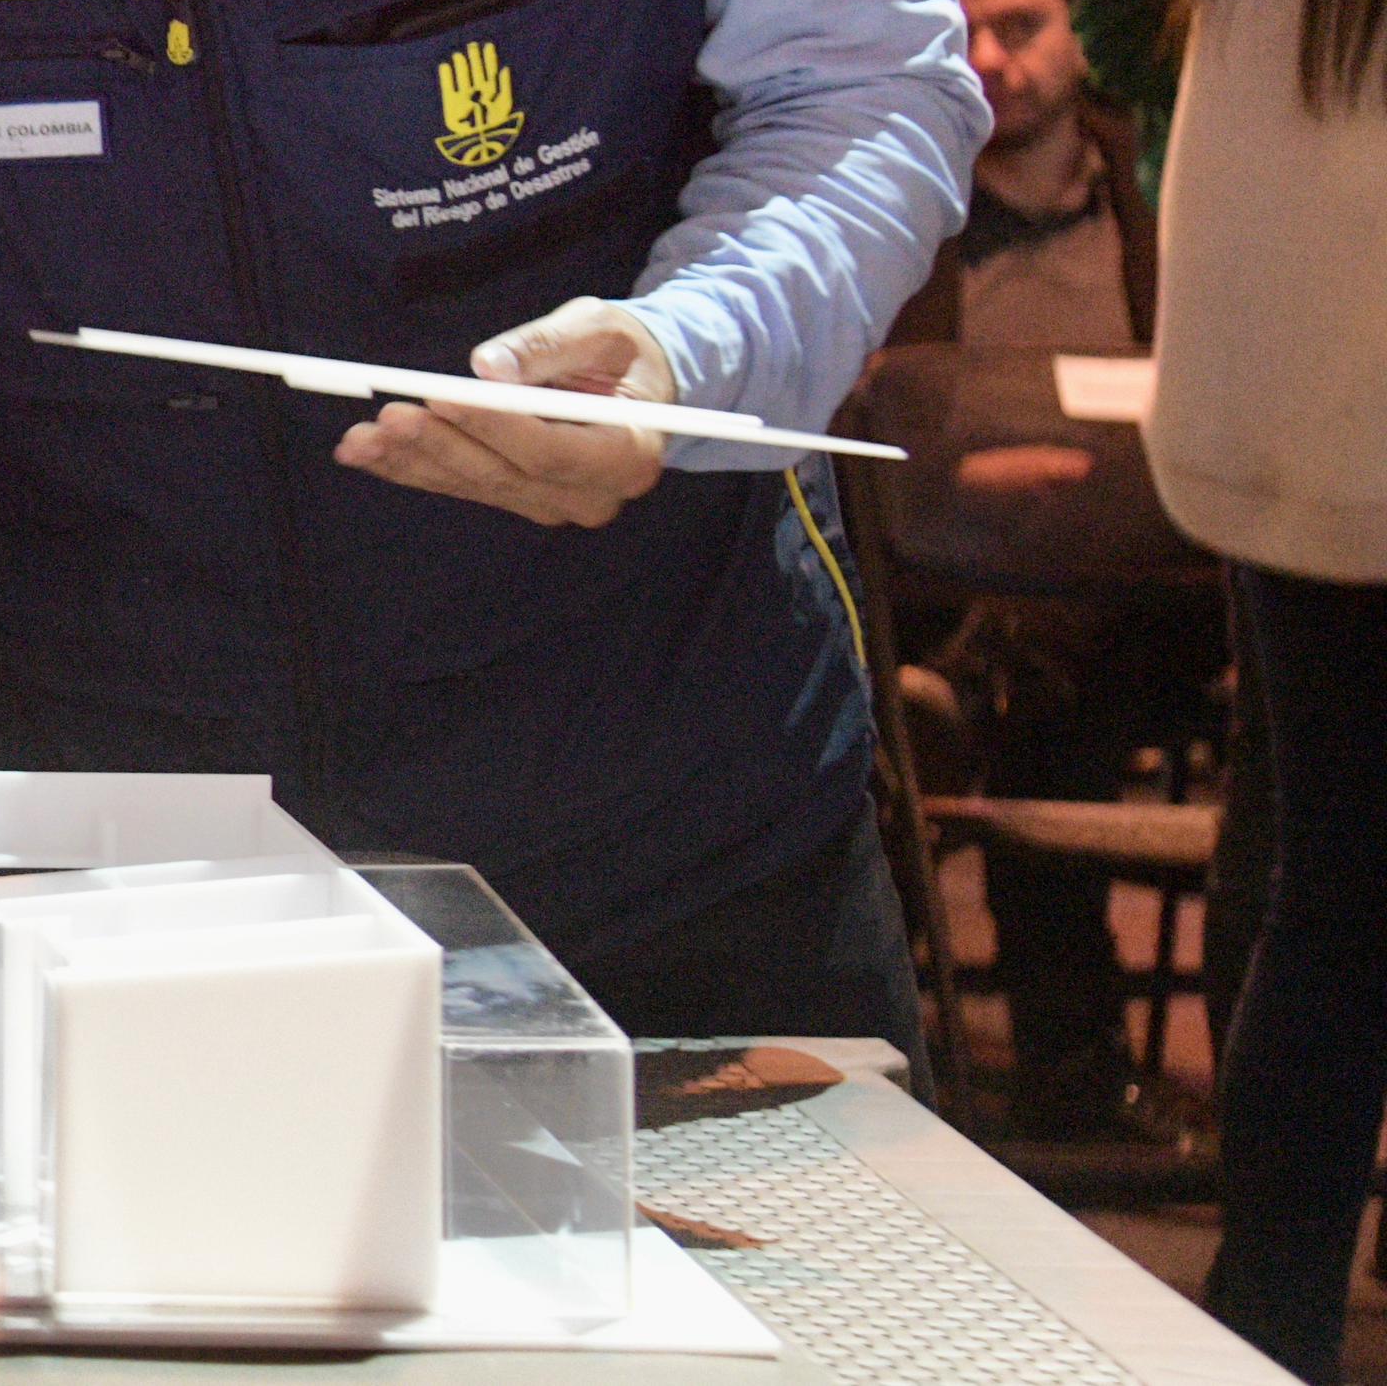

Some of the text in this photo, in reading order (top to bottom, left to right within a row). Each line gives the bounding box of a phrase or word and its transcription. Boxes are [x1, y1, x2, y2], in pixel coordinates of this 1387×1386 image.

[6, 121, 94, 138] COLOMBIA
[372, 187, 442, 208] Sistema
[443, 163, 510, 200] Nacional
[513, 155, 535, 176] de
[392, 208, 420, 228] del
[485, 190, 508, 210] de
[509, 157, 591, 200] Desastres
